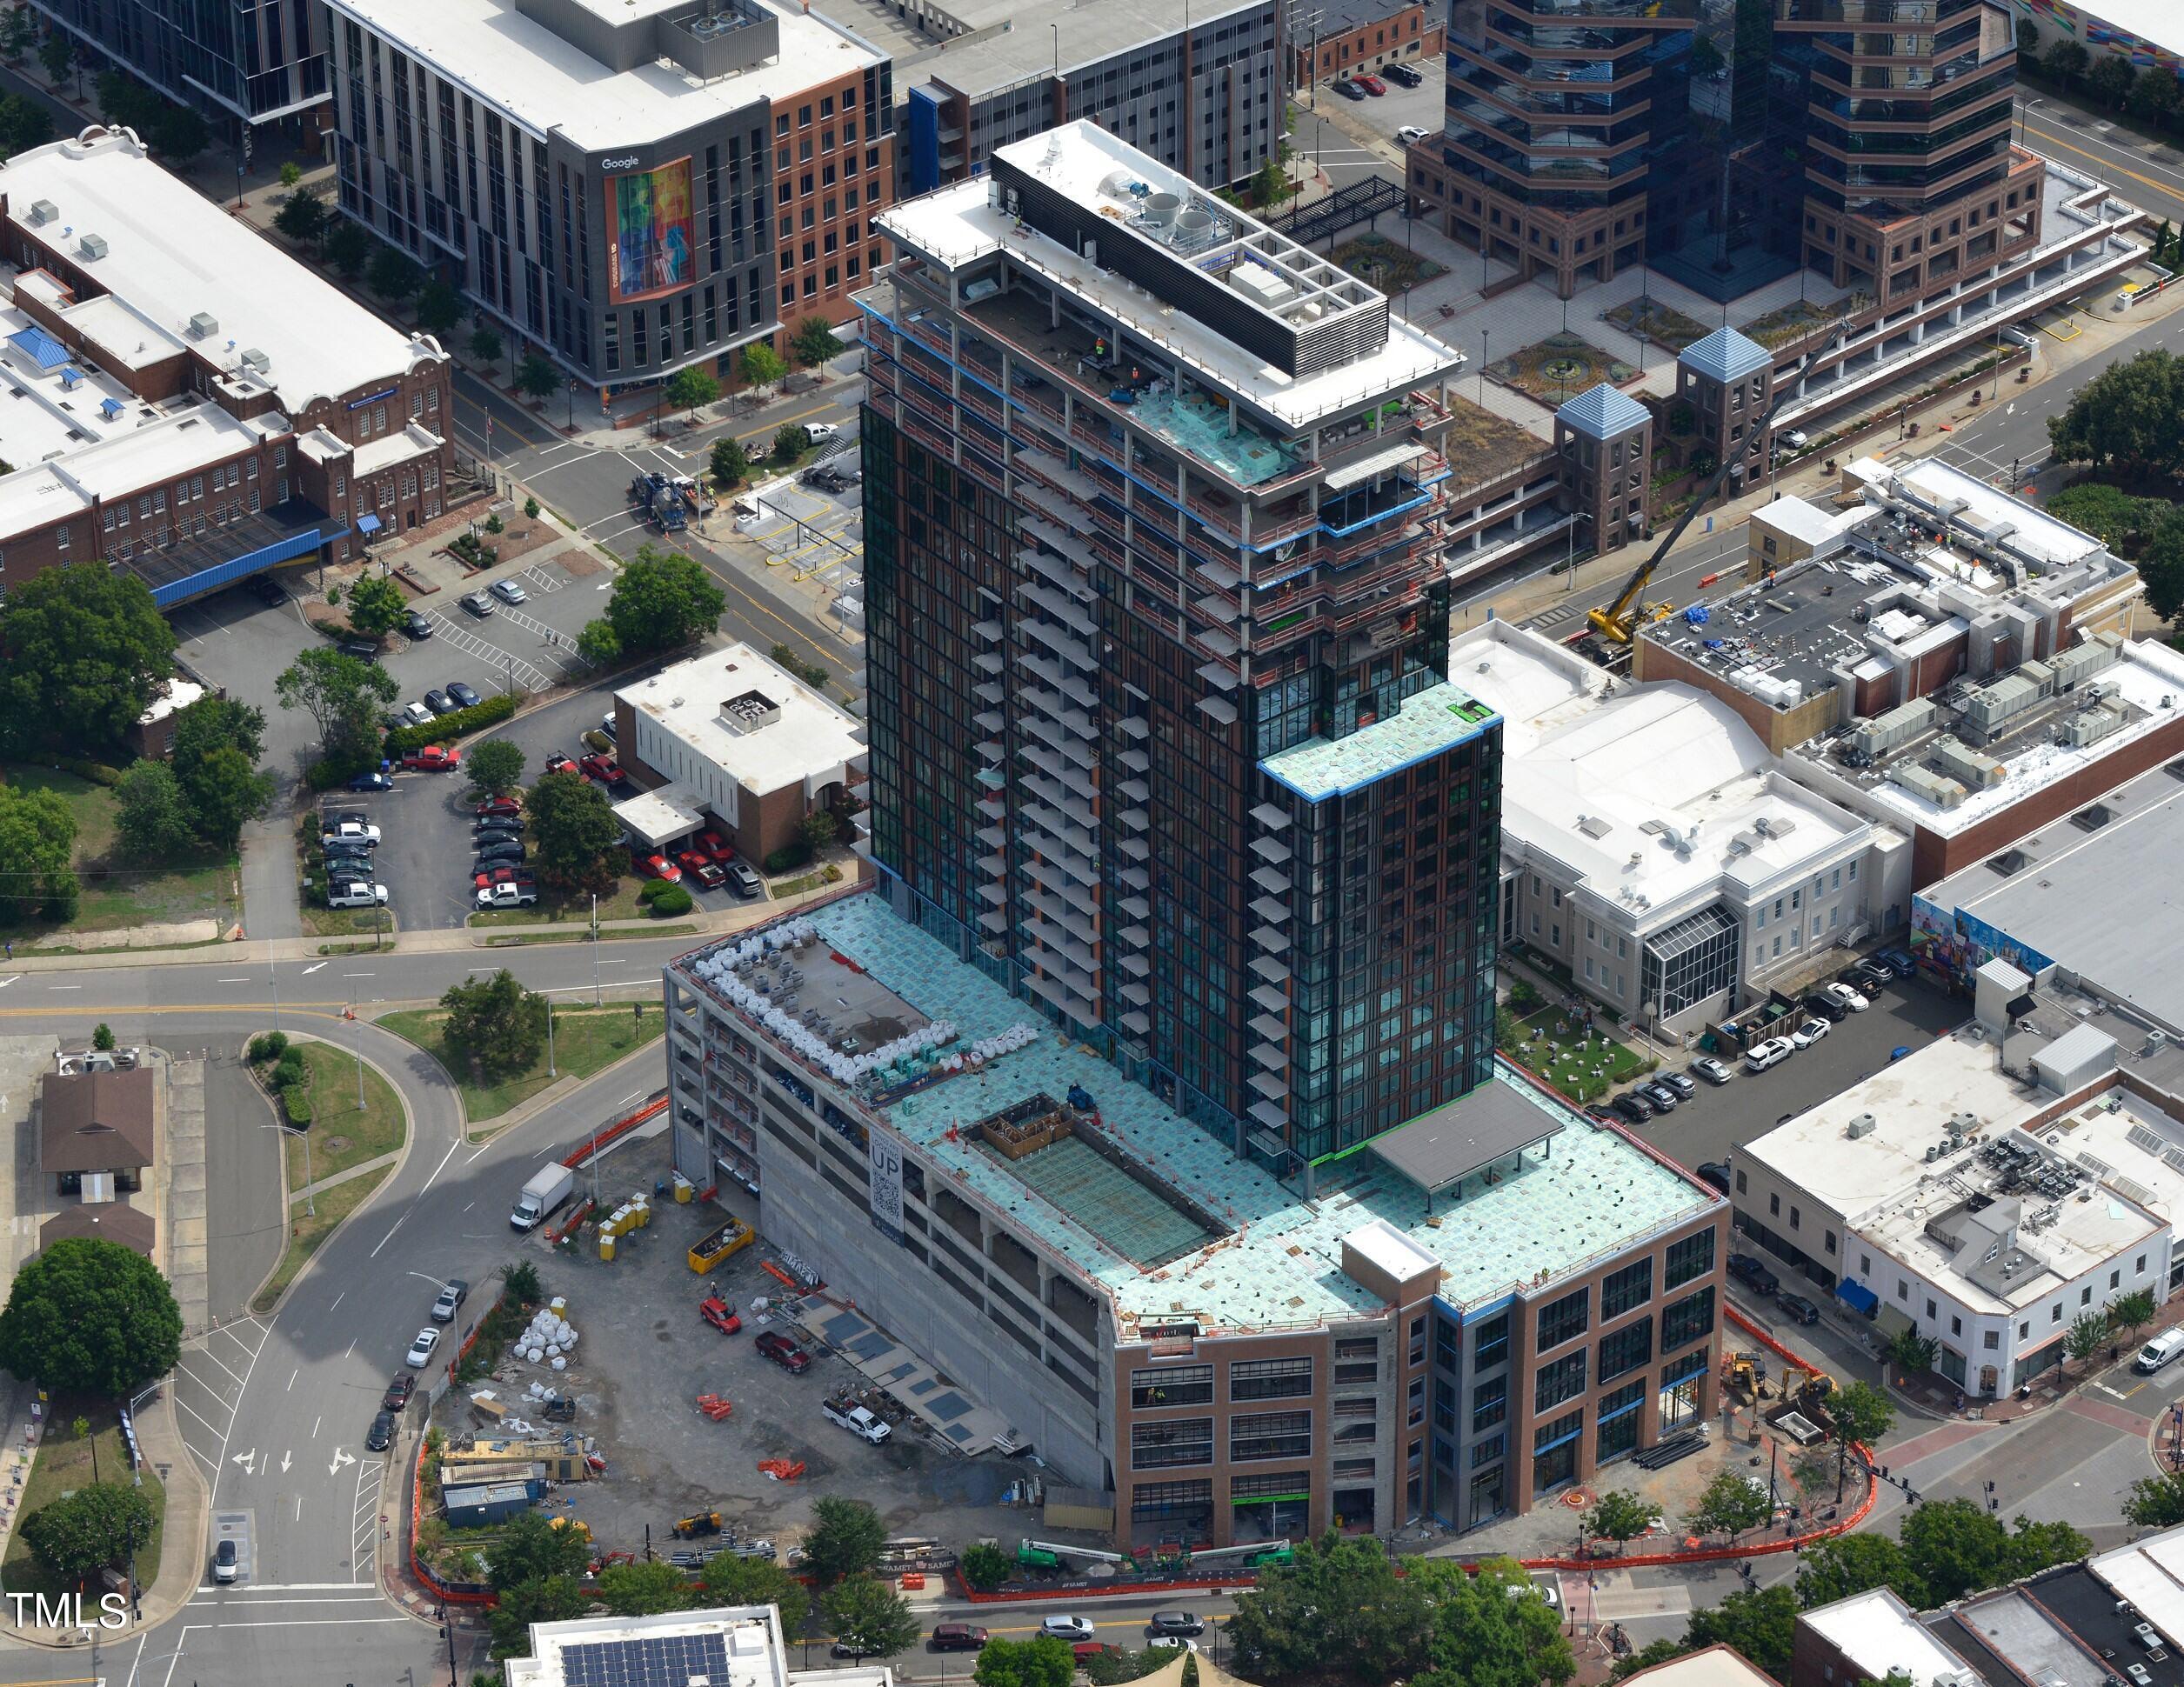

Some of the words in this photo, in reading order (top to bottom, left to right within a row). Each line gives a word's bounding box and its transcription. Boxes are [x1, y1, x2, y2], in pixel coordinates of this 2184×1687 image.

[602, 156, 639, 170] Google
[872, 1137, 899, 1161] LOOKING
[872, 1145, 899, 1177] UP
[927, 1560, 955, 1570] SAMET
